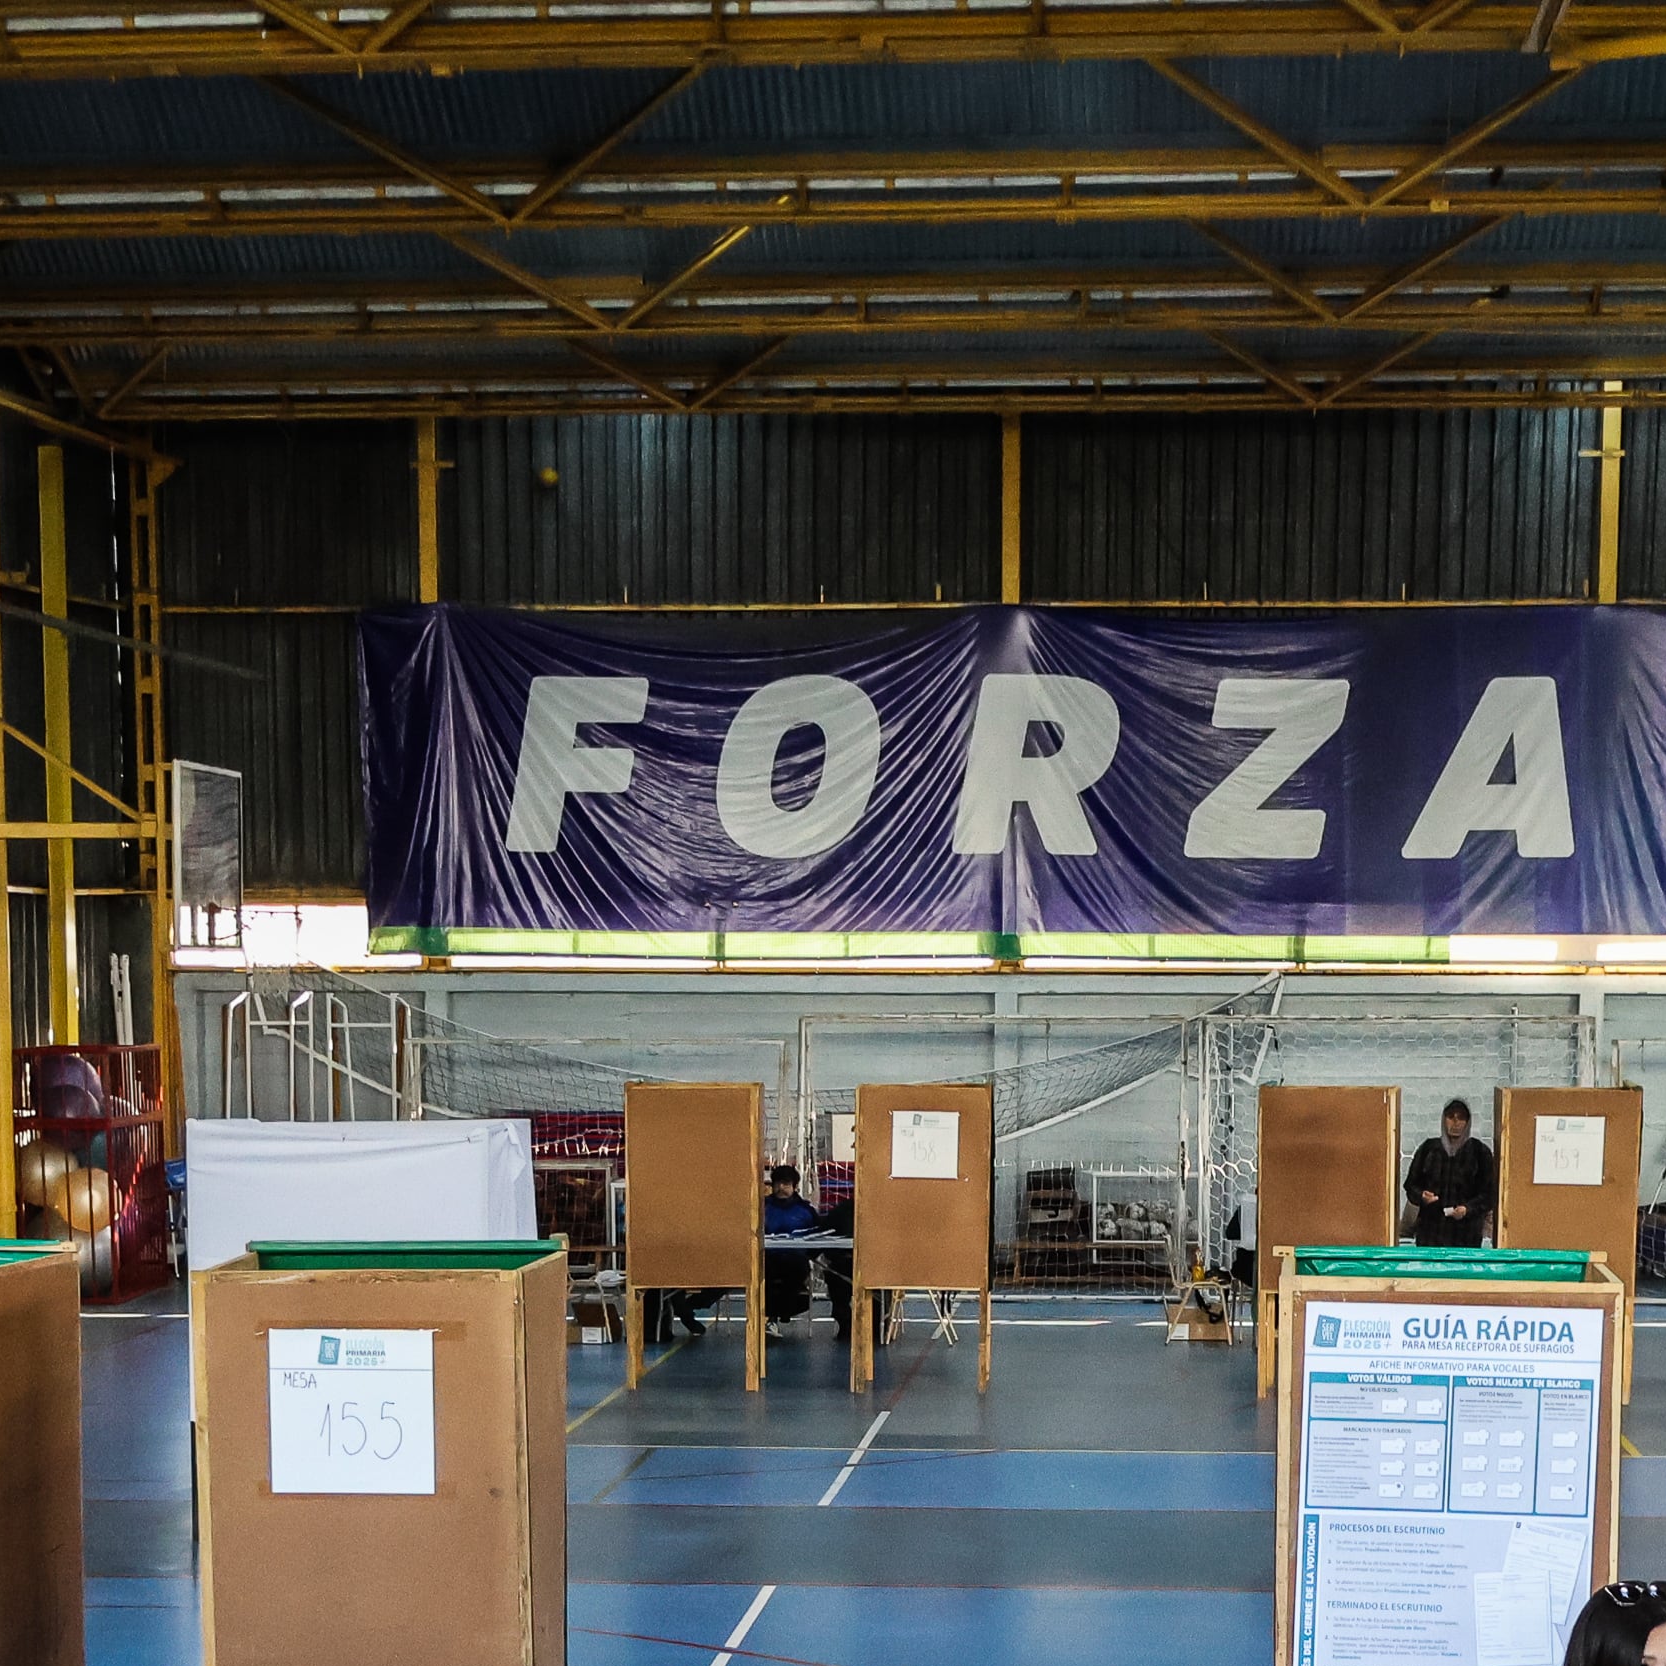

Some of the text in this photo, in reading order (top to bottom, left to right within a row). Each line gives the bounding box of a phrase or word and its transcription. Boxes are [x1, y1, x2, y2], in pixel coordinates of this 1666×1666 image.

[505, 674, 1575, 859] FORZA
[1344, 1319, 1390, 1332] ELECCIÓN
[1403, 1314, 1574, 1342] GUÍA RÁPIDA
[1344, 1331, 1391, 1339] PRIMARIA
[1402, 1340, 1575, 1354] PARA MESA RECEPTORA DE SUFRAGIOS
[1369, 1360, 1535, 1374] AFICHE INFORMATIVO PARA VOCALES
[283, 1371, 317, 1388] MESA
[1347, 1373, 1413, 1384] VOTOS VÁLIDOS
[1466, 1377, 1581, 1388] VOTOS NULOS Y EN BLANCO
[320, 1401, 403, 1460] 155
[1329, 1523, 1446, 1535] PROCESOS DEL ESCRUTINIO
[1306, 1522, 1317, 1570] VOTACIÓN
[1306, 1572, 1315, 1585] LA
[1305, 1586, 1314, 1600] DE
[1327, 1600, 1443, 1613] TERMINADO EL ESCRUTINIO
[1304, 1601, 1313, 1636] CIERRE
[1303, 1638, 1312, 1655] DEL
